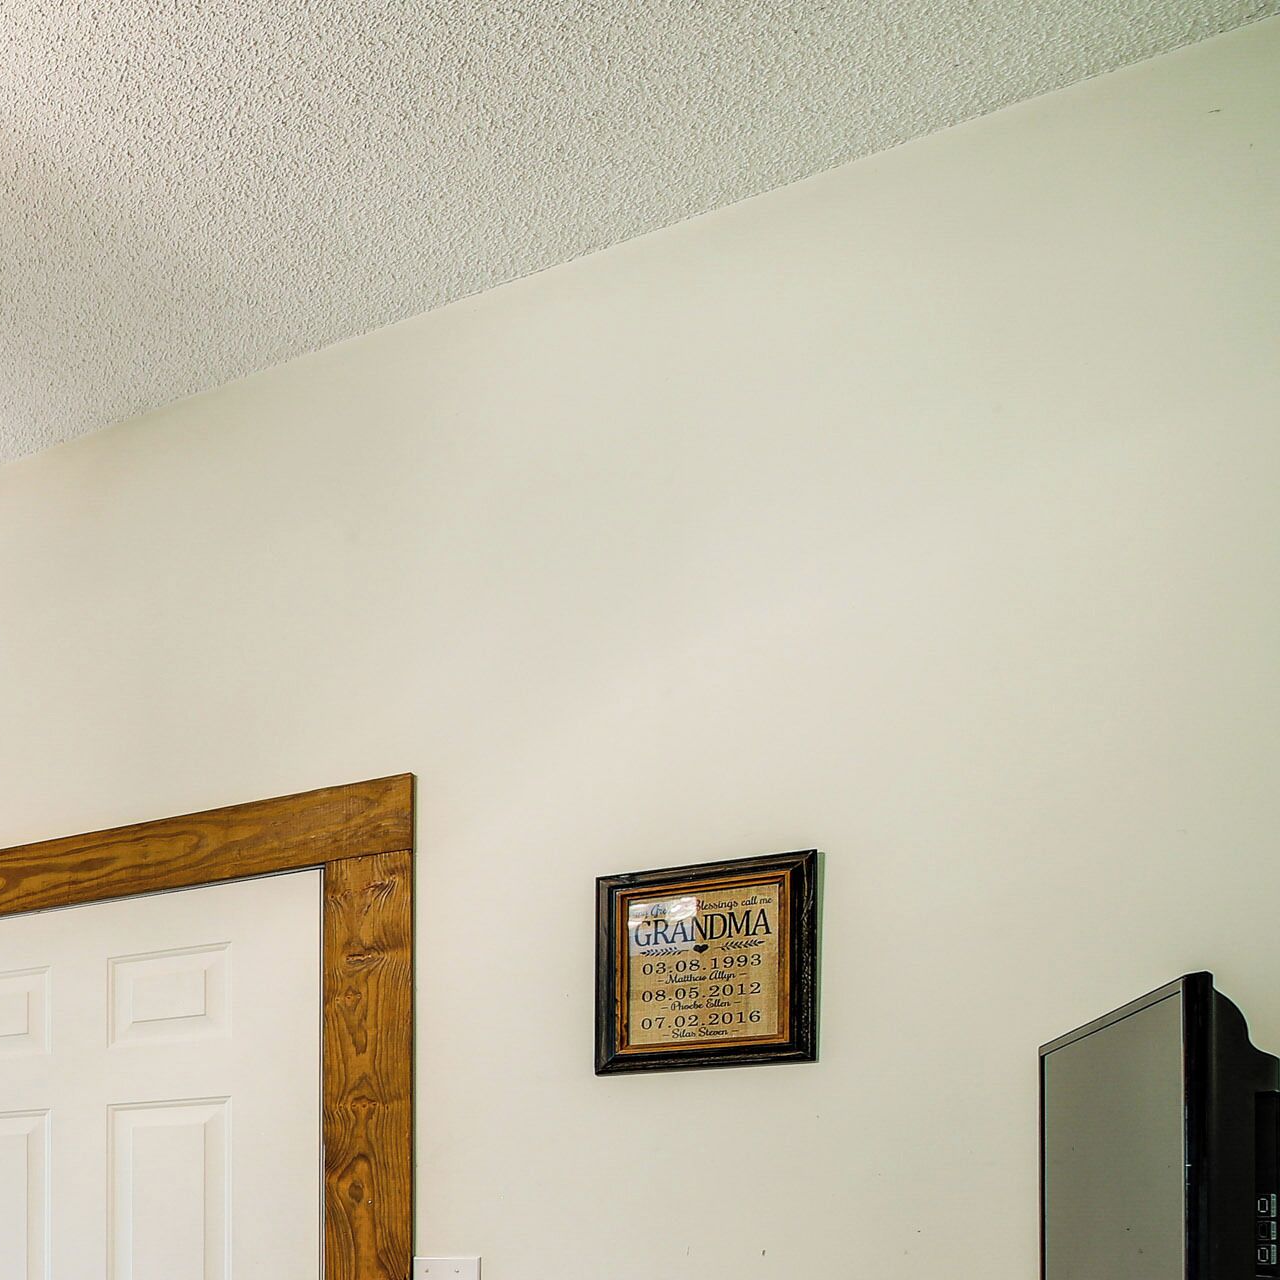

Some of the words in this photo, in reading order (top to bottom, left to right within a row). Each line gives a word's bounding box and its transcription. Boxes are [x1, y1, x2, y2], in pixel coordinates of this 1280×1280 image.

[741, 896, 758, 906] call
[635, 908, 772, 946] GRANDMA
[642, 954, 762, 975] 03.08.1993
[665, 973, 707, 984] Matthew
[709, 970, 736, 981] Allyn
[642, 982, 761, 1002] 08.05.2012
[670, 1000, 703, 1011] Phoebe
[705, 998, 730, 1008] Ellen
[641, 1010, 761, 1029] 07.02.2016
[672, 1028, 696, 1038] Silas
[698, 1027, 728, 1037] Steven
